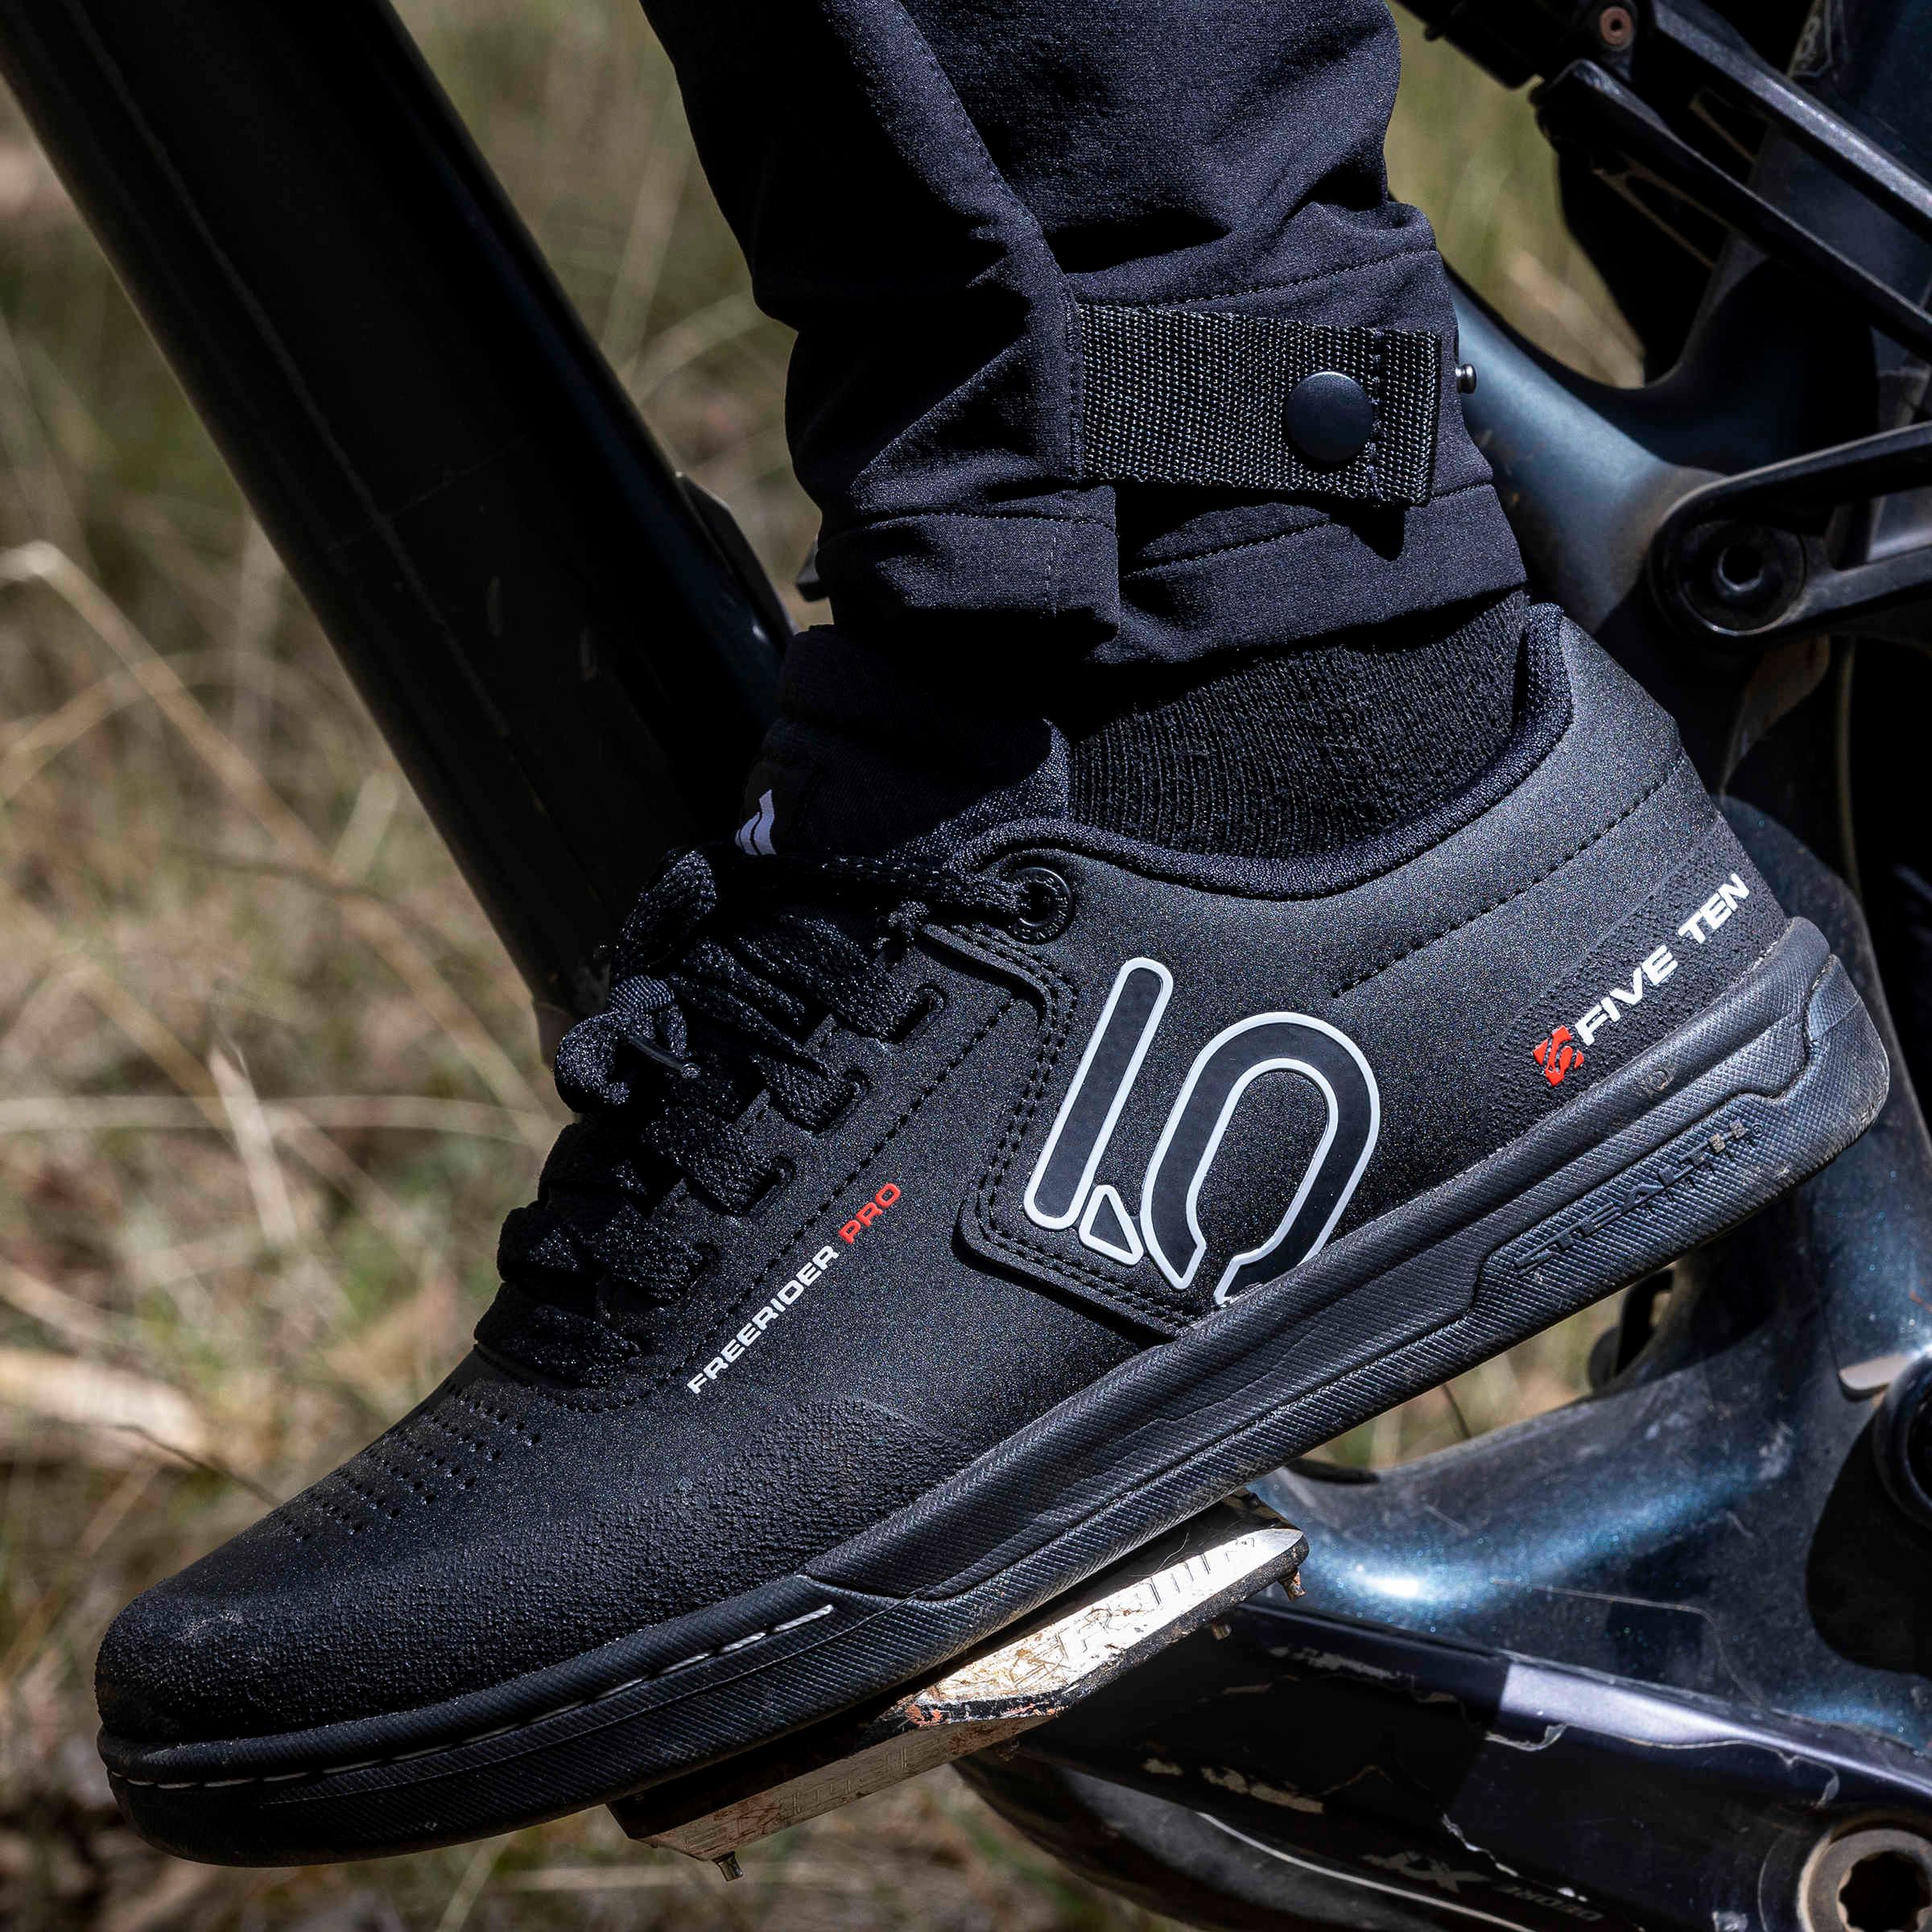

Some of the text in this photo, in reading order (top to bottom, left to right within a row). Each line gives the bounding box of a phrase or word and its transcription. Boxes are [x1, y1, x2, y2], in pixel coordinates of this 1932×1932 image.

[1575, 873, 1749, 1046] FIVE TEN
[687, 1183, 901, 1393] FREERIDER PRO
